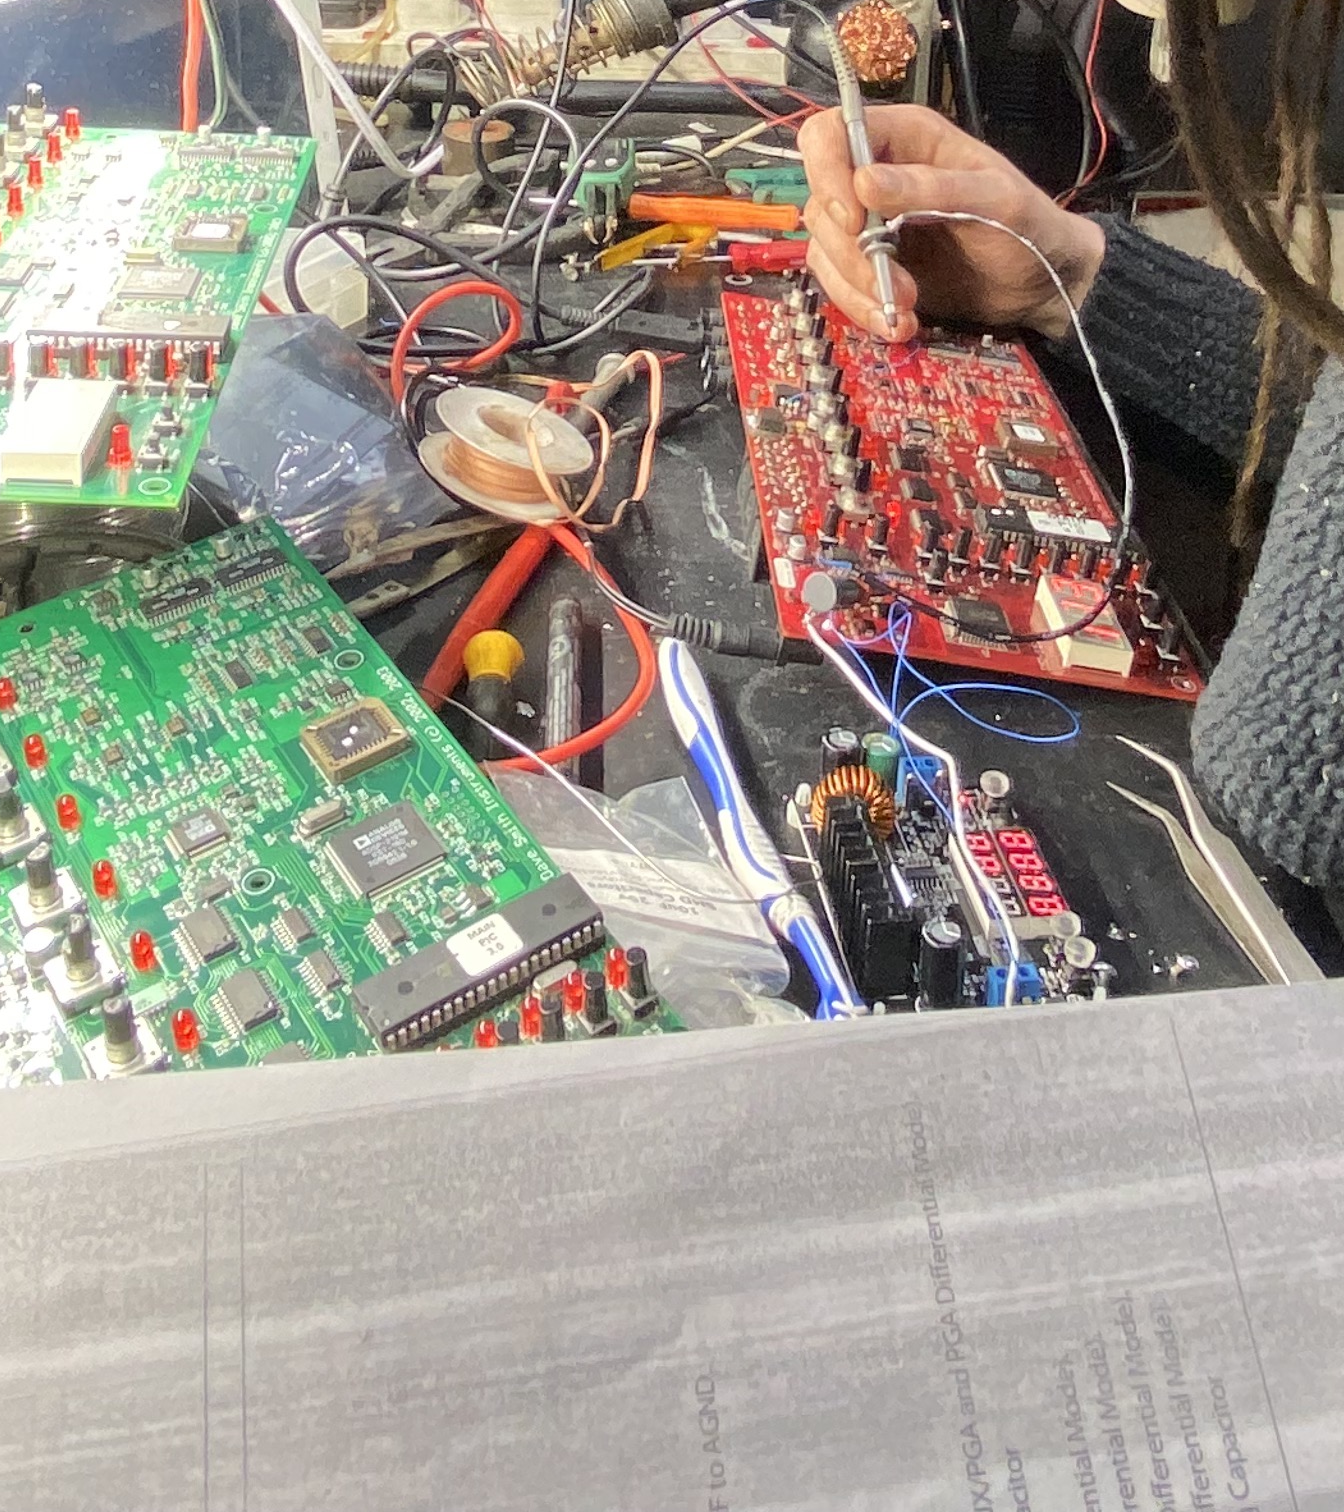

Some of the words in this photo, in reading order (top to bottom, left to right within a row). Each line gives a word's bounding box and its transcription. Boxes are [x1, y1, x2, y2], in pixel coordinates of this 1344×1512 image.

[441, 743, 500, 813] Instruments
[497, 810, 528, 848] Smith
[526, 849, 554, 882] Dave
[466, 920, 496, 940] MAIN
[478, 932, 498, 947] PIC
[915, 1177, 955, 1304] Differential
[940, 1308, 967, 1362] PGA
[949, 1368, 976, 1416] and
[1169, 1393, 1215, 1512] fferential
[1207, 1375, 1251, 1501] Capacitor
[709, 1459, 727, 1490] to
